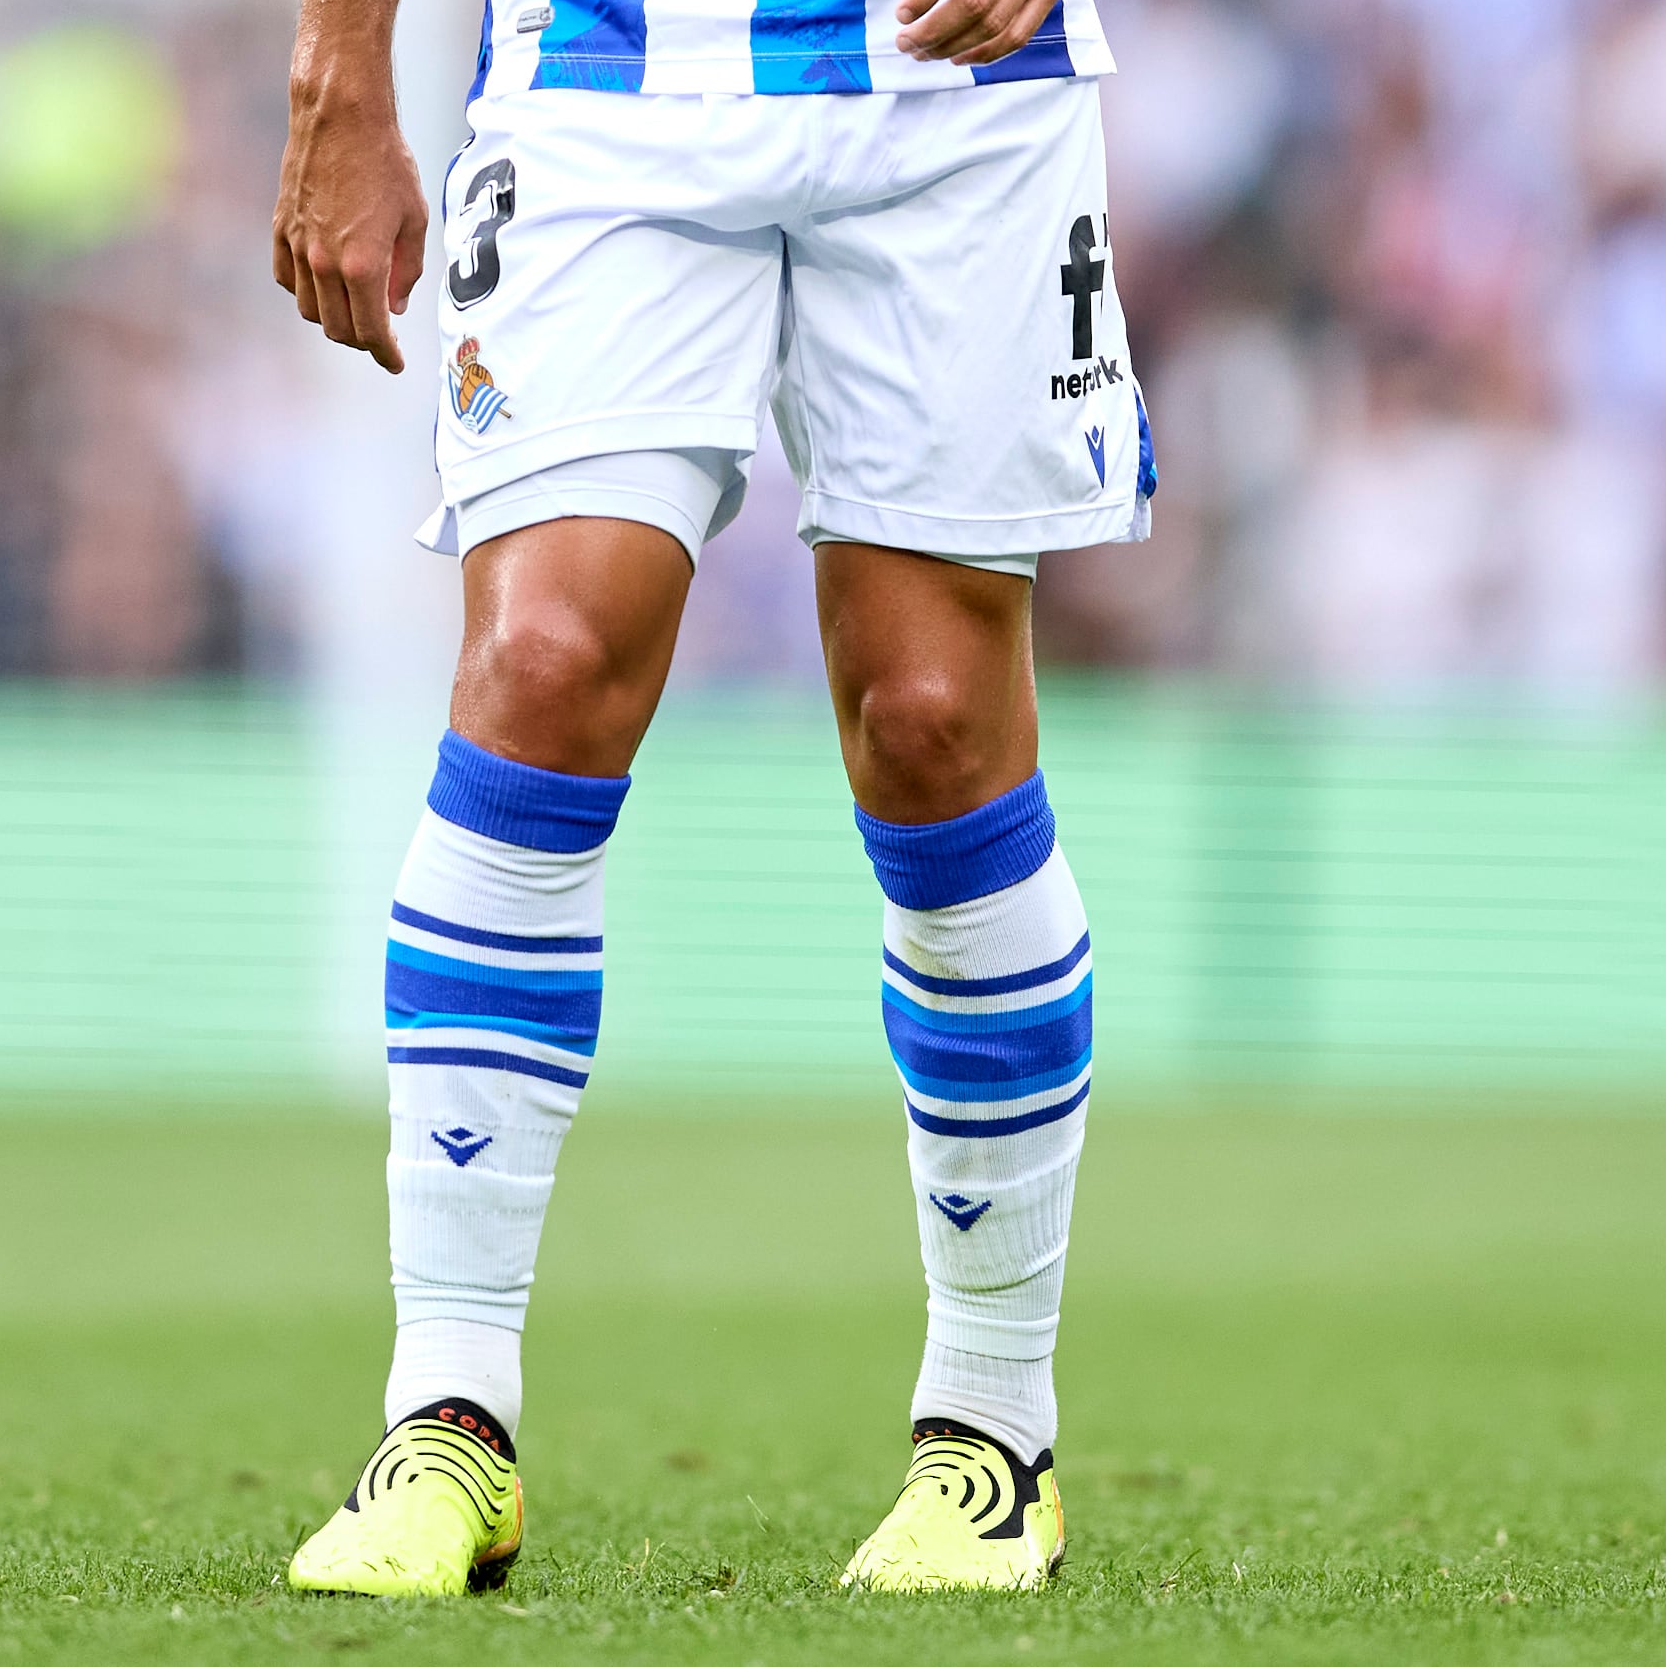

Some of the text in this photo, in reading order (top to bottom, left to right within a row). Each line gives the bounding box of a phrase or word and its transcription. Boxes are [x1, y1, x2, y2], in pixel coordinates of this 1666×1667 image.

[445, 157, 516, 312] 3
[1060, 213, 1108, 360] f
[438, 1407, 500, 1453] COPA
